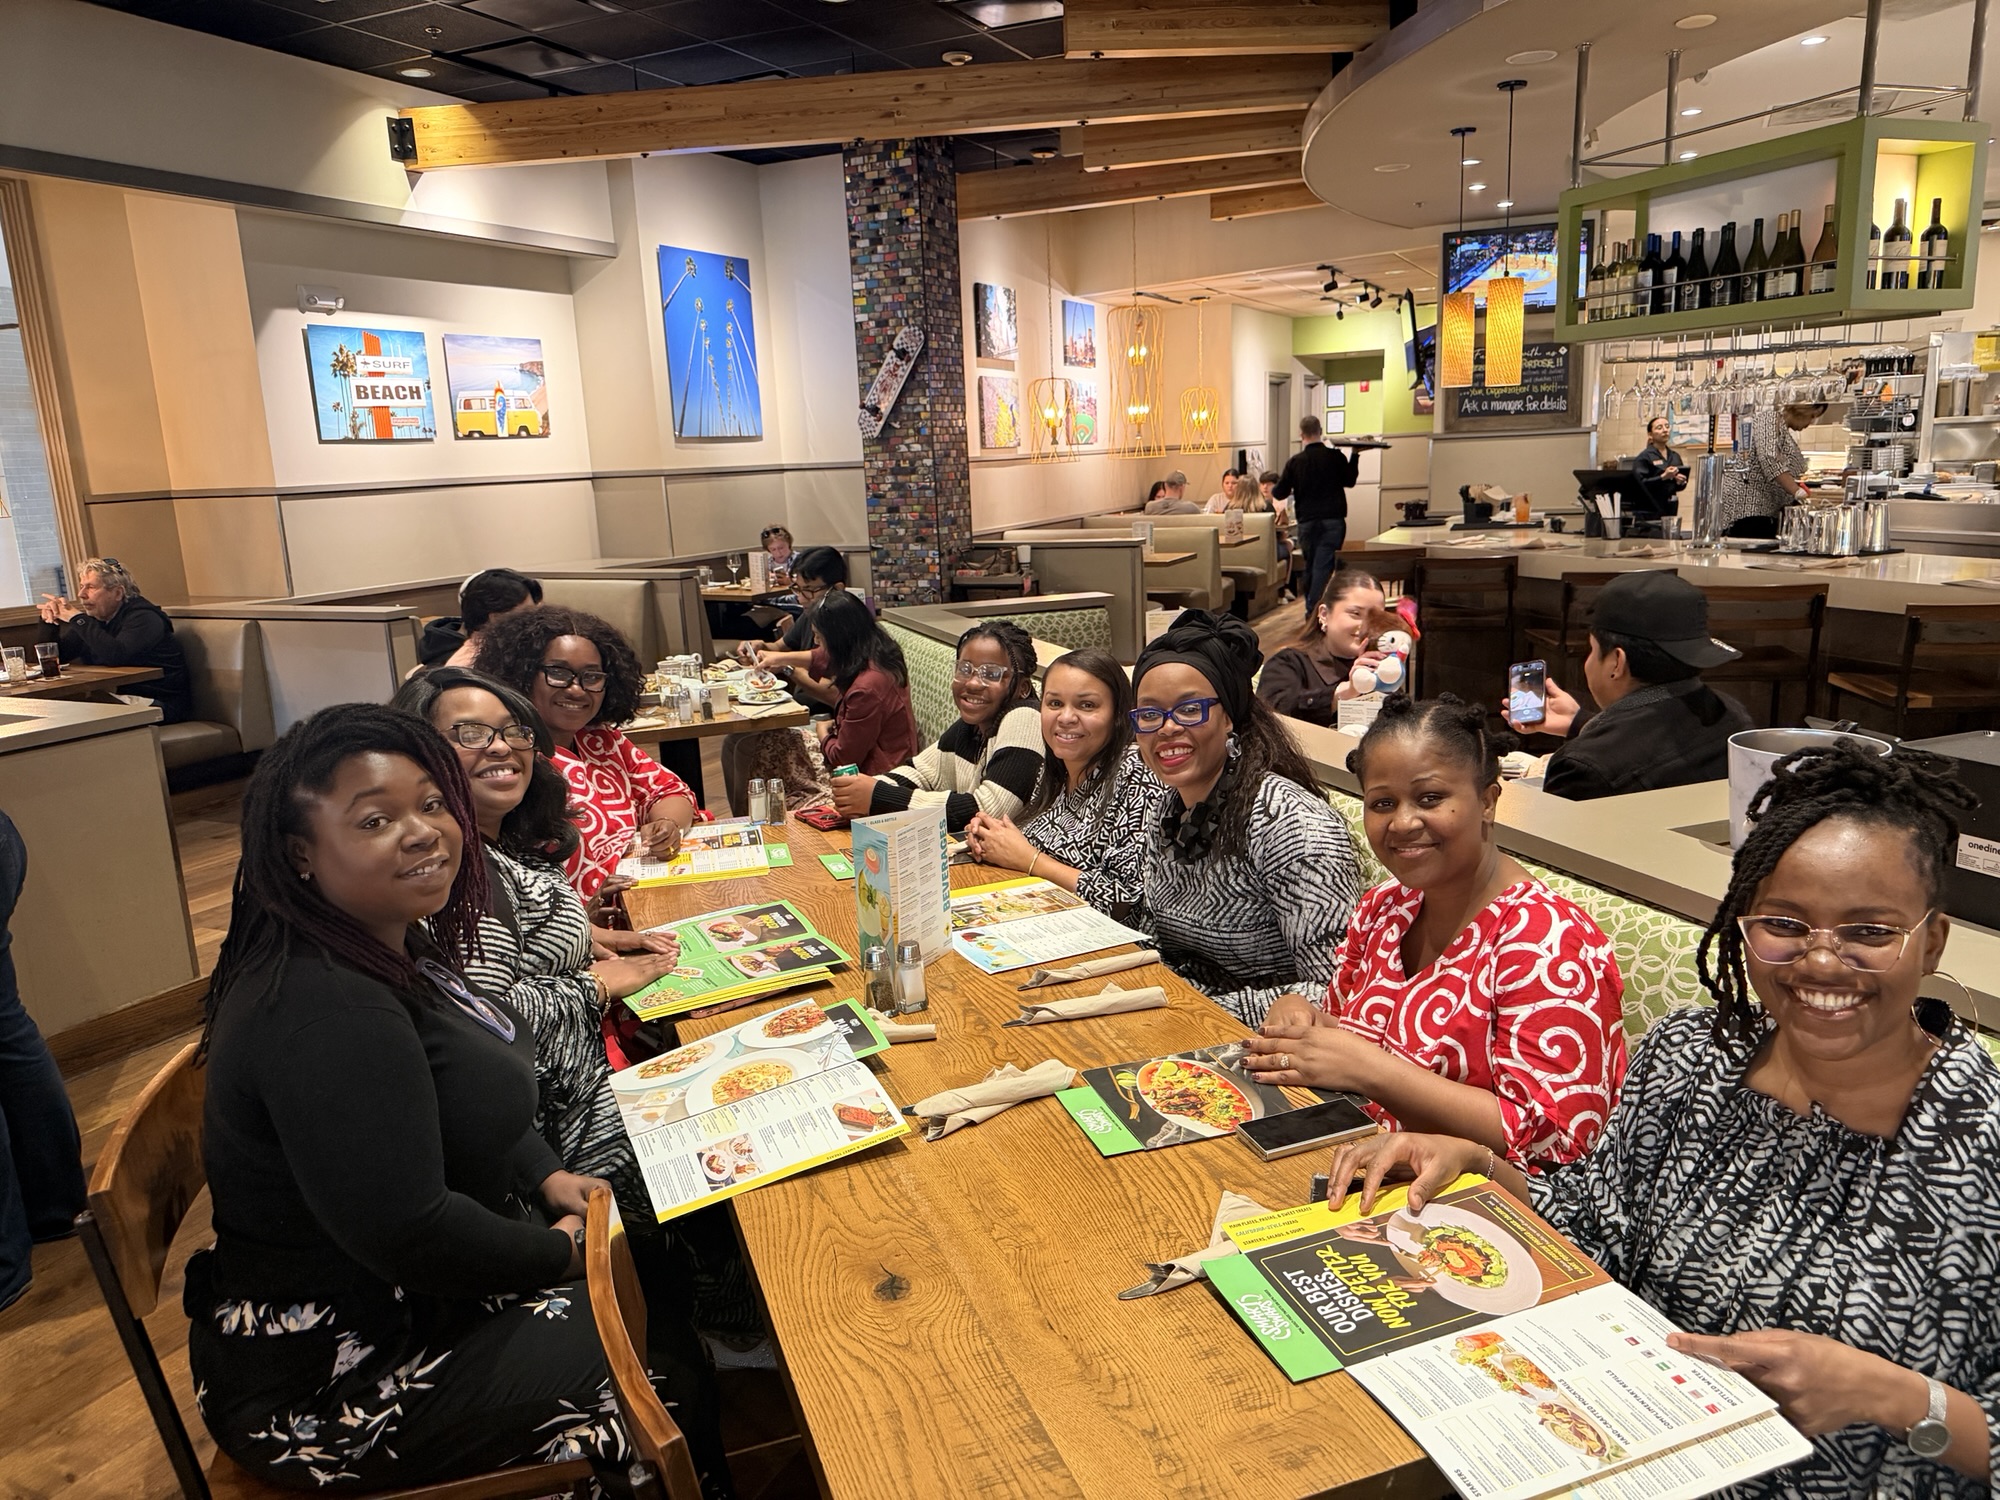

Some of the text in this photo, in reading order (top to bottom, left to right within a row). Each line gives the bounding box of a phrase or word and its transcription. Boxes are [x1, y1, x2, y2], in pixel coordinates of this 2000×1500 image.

[372, 360, 411, 369] SURF
[355, 385, 422, 400] BEACH
[1461, 394, 1567, 414] Ask a manager for details
[939, 818, 951, 912] BEVERAGES
[833, 1018, 853, 1035] PLANT
[1241, 1218, 1258, 1226] PLATES,
[1242, 1236, 1265, 1246] STARTERS,
[1289, 1226, 1304, 1234] SOUPS
[1315, 1244, 1377, 1294] BETTER
[1348, 1253, 1417, 1308] FOR YOU
[1283, 1270, 1328, 1302] BEST
[1235, 1300, 1281, 1335] SMART
[1316, 1302, 1356, 1330] OUR
[1363, 1298, 1410, 1327] NOW
[1604, 1369, 1674, 1430] COMPLIMENTARY REFILLS
[1690, 1368, 1737, 1406] BOTTLED WATER
[1557, 1377, 1630, 1445] HAND-CRAFTED MOCKTAILS
[1453, 1468, 1481, 1497] STARTERS
